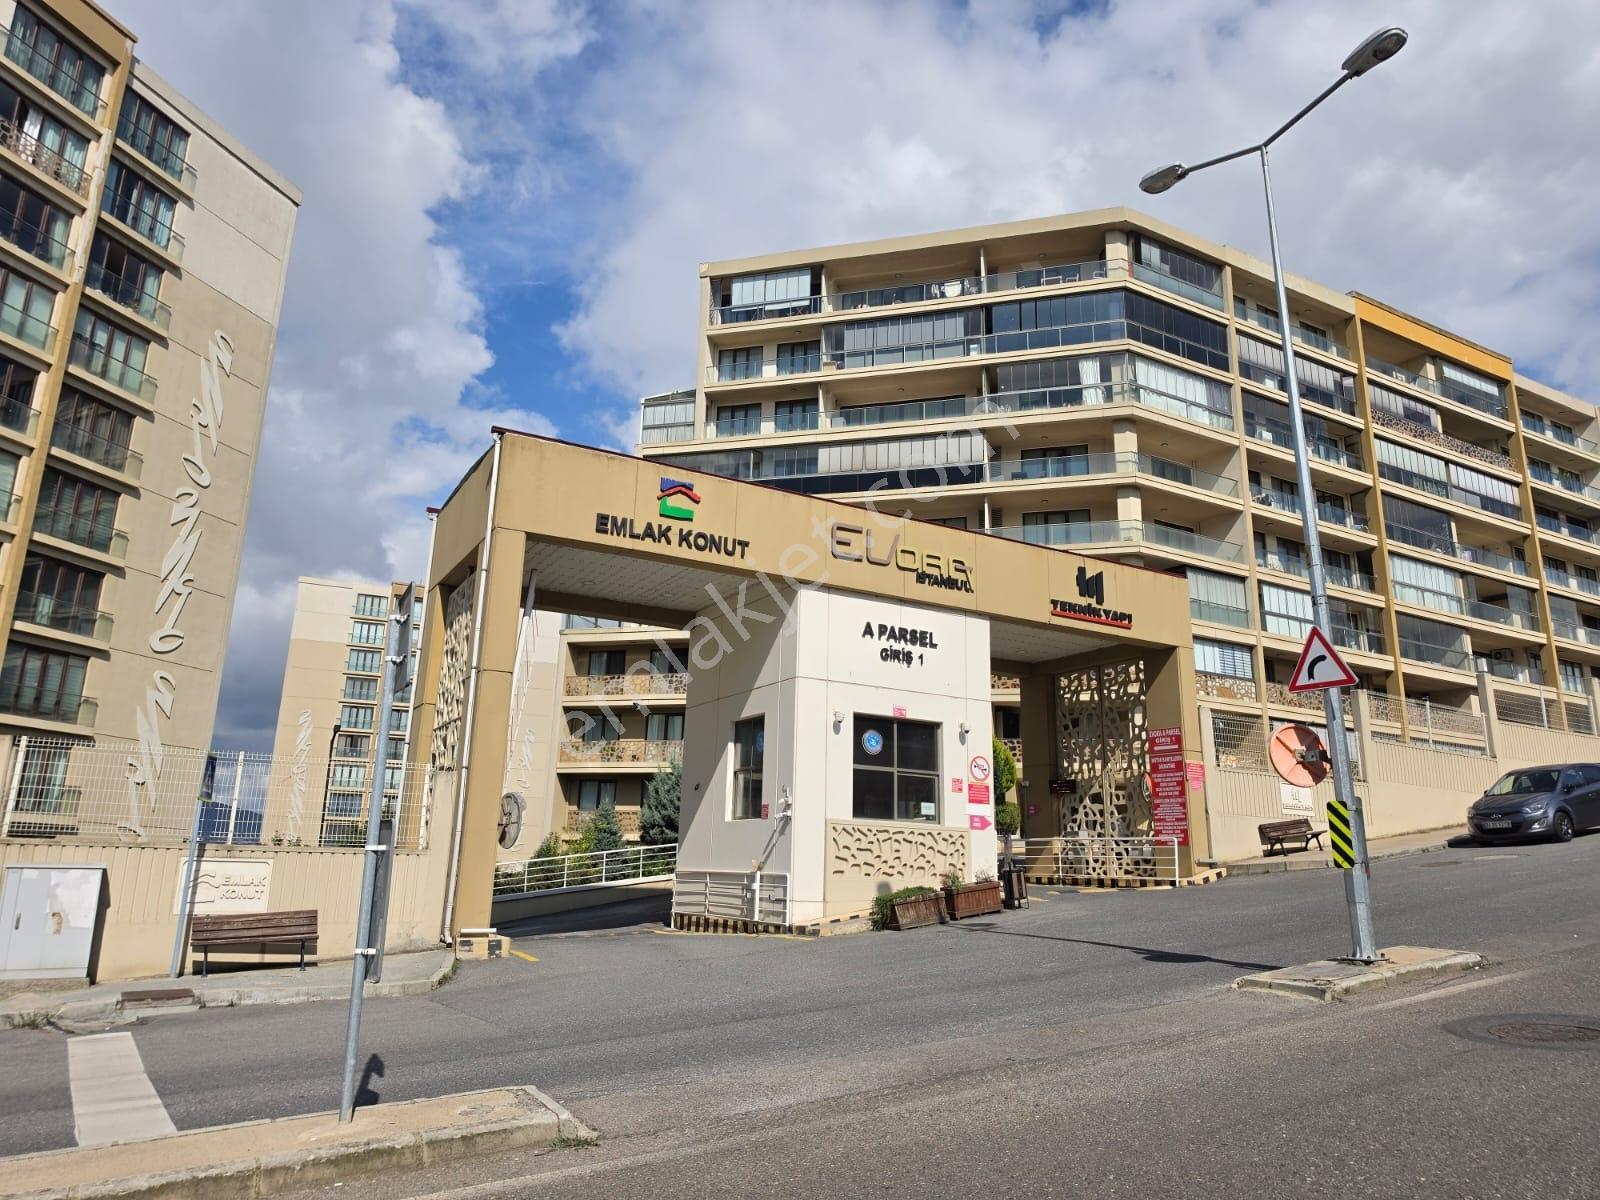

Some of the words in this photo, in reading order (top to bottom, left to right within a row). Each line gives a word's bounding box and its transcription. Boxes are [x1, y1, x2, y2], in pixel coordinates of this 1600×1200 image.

[595, 512, 672, 545] EMLAK
[678, 528, 750, 559] KONUT
[1102, 608, 1133, 625] YAPI
[862, 621, 874, 639] A
[878, 623, 939, 649] PARSEL
[880, 645, 914, 668] GİRİŞ
[918, 653, 924, 667] 1
